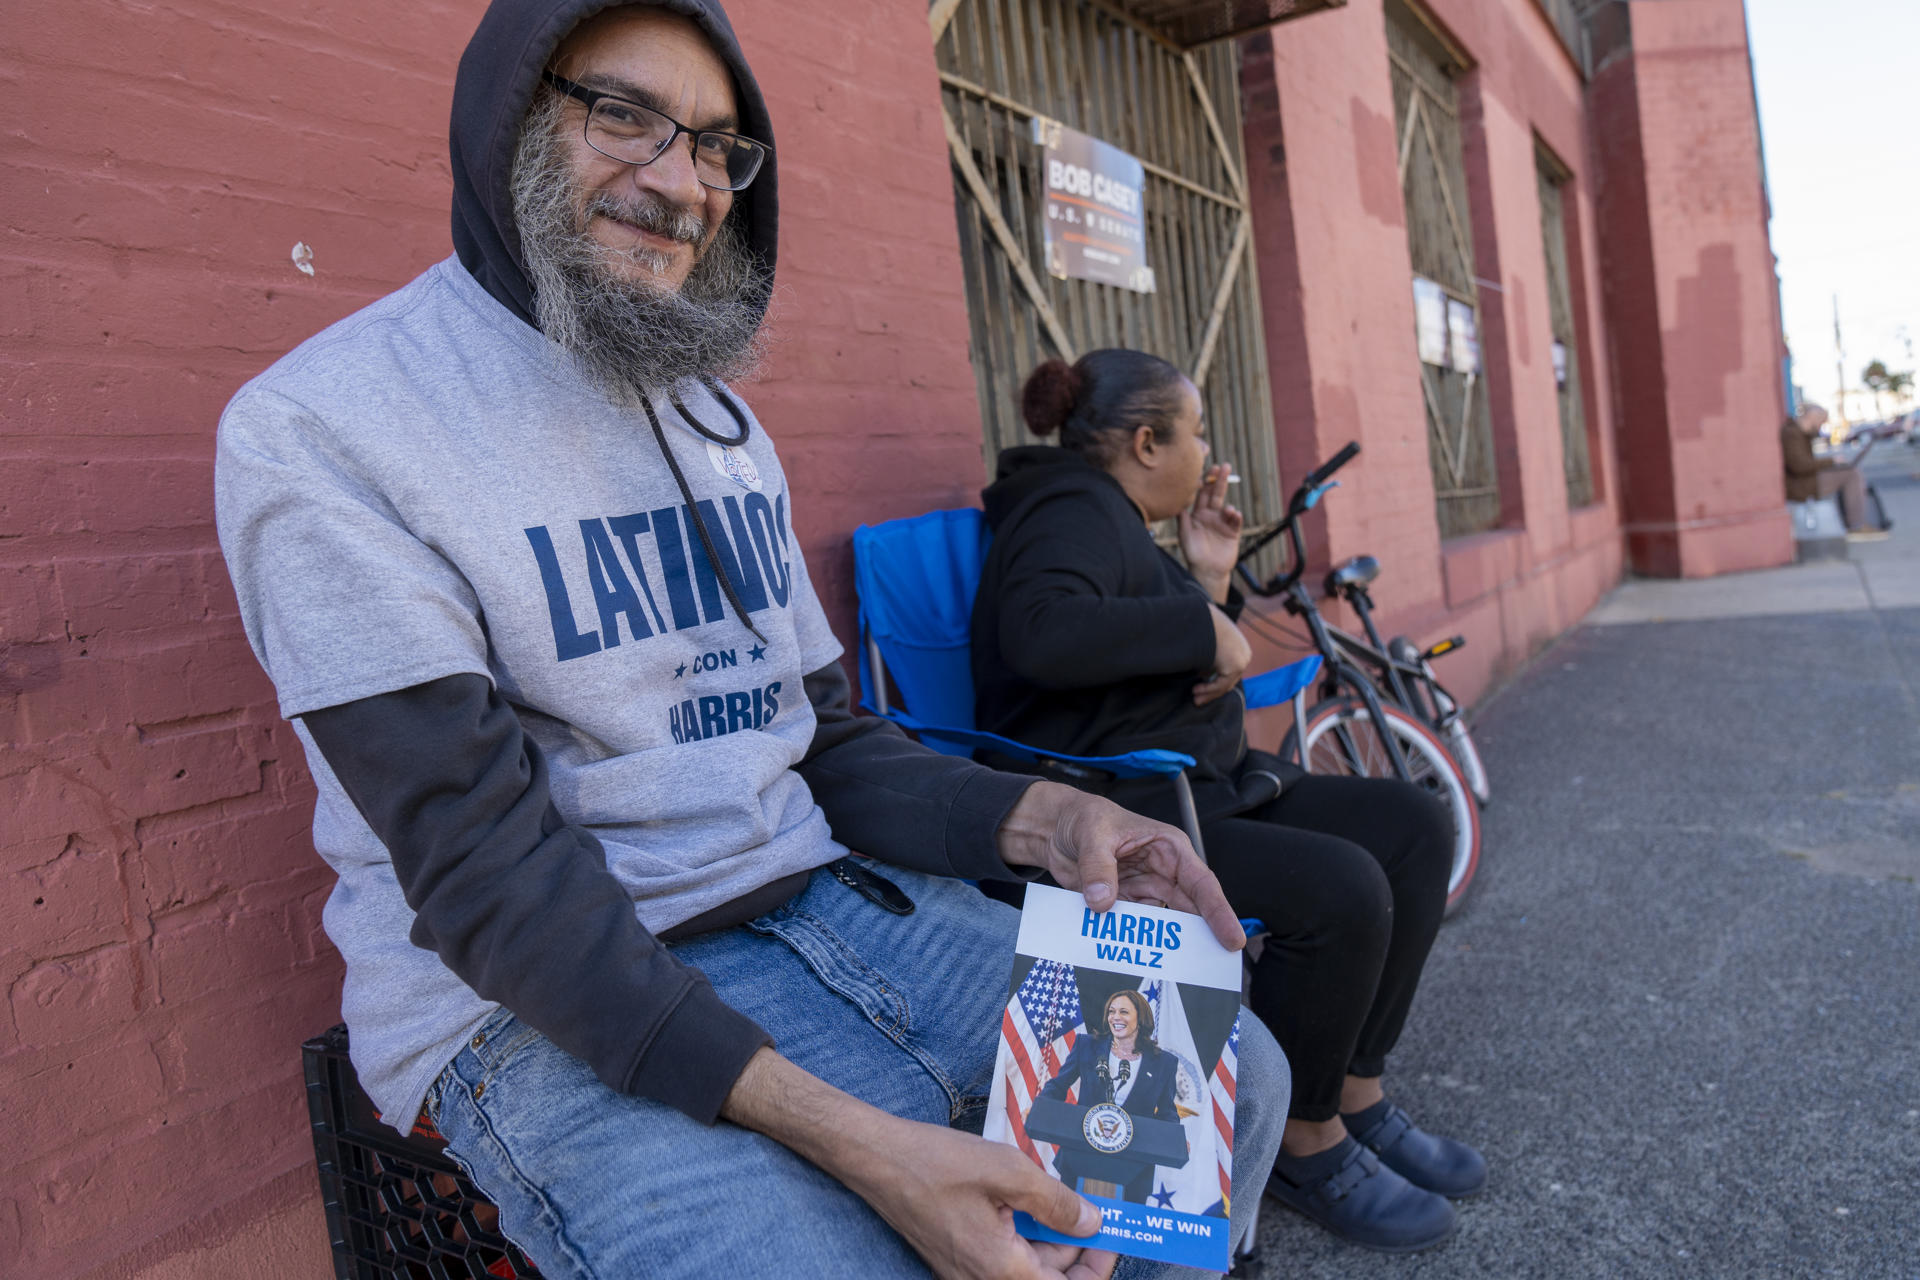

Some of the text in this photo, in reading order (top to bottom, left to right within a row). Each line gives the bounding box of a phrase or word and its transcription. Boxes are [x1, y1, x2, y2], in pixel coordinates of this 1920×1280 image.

[1049, 159, 1092, 197] BOB
[693, 648, 738, 674] CON
[668, 681, 782, 745] HARRIS
[1081, 907, 1182, 950] HARRIS
[1096, 943, 1163, 969] WALZ
[1146, 1216, 1173, 1230] WE
[1177, 1221, 1212, 1237] WIN
